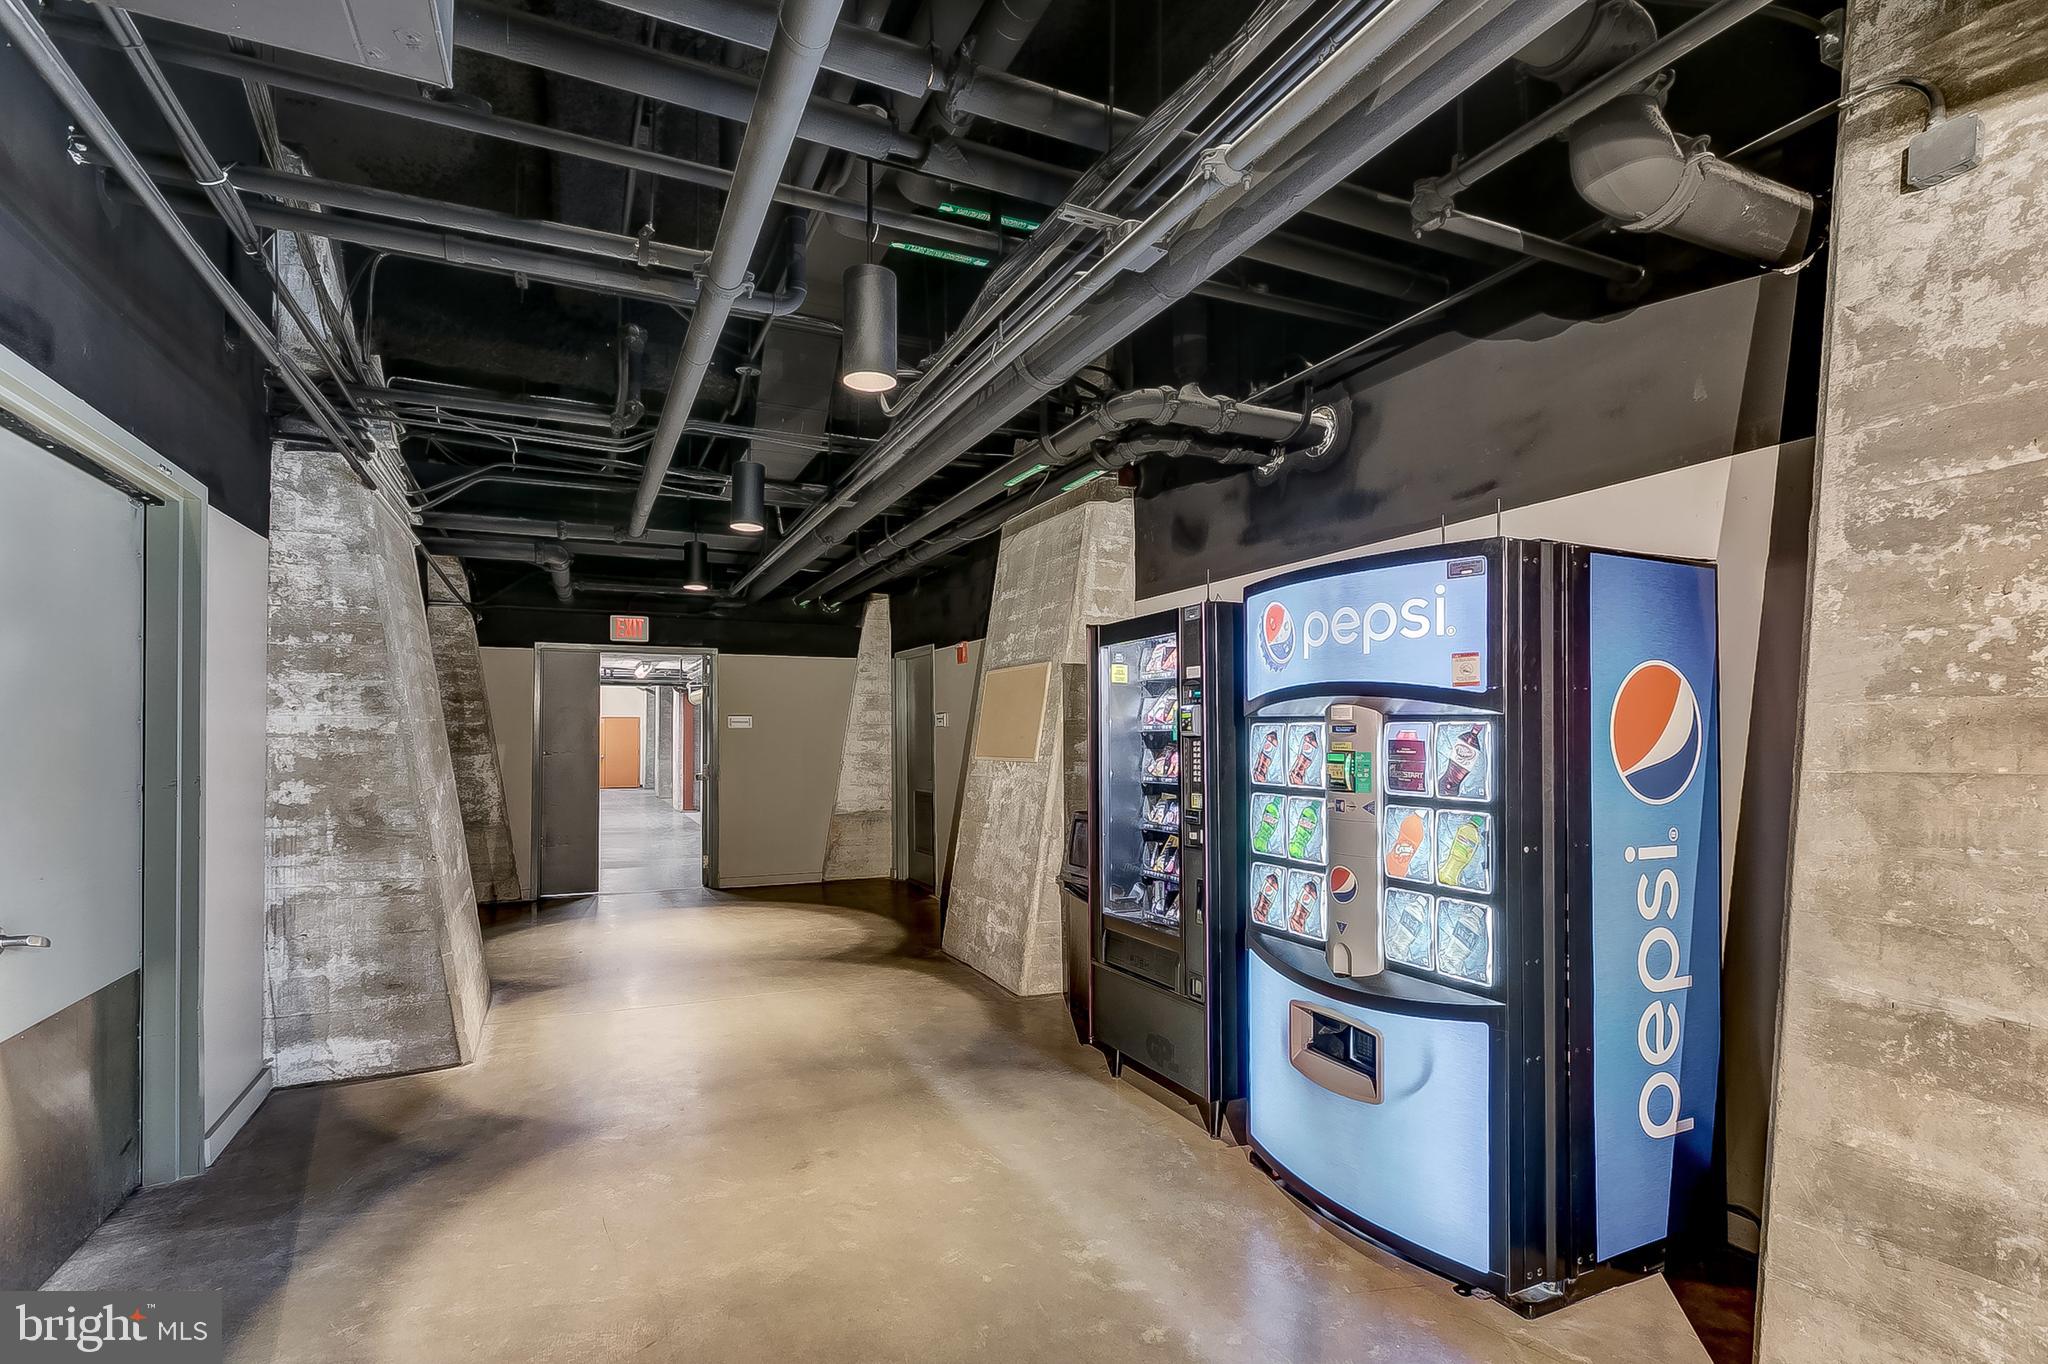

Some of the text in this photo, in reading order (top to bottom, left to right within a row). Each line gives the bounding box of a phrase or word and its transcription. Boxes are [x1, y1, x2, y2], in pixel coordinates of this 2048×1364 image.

[615, 618, 645, 640] EXIT
[1303, 584, 1447, 660] pepsi
[1624, 844, 1694, 1140] pepsi
